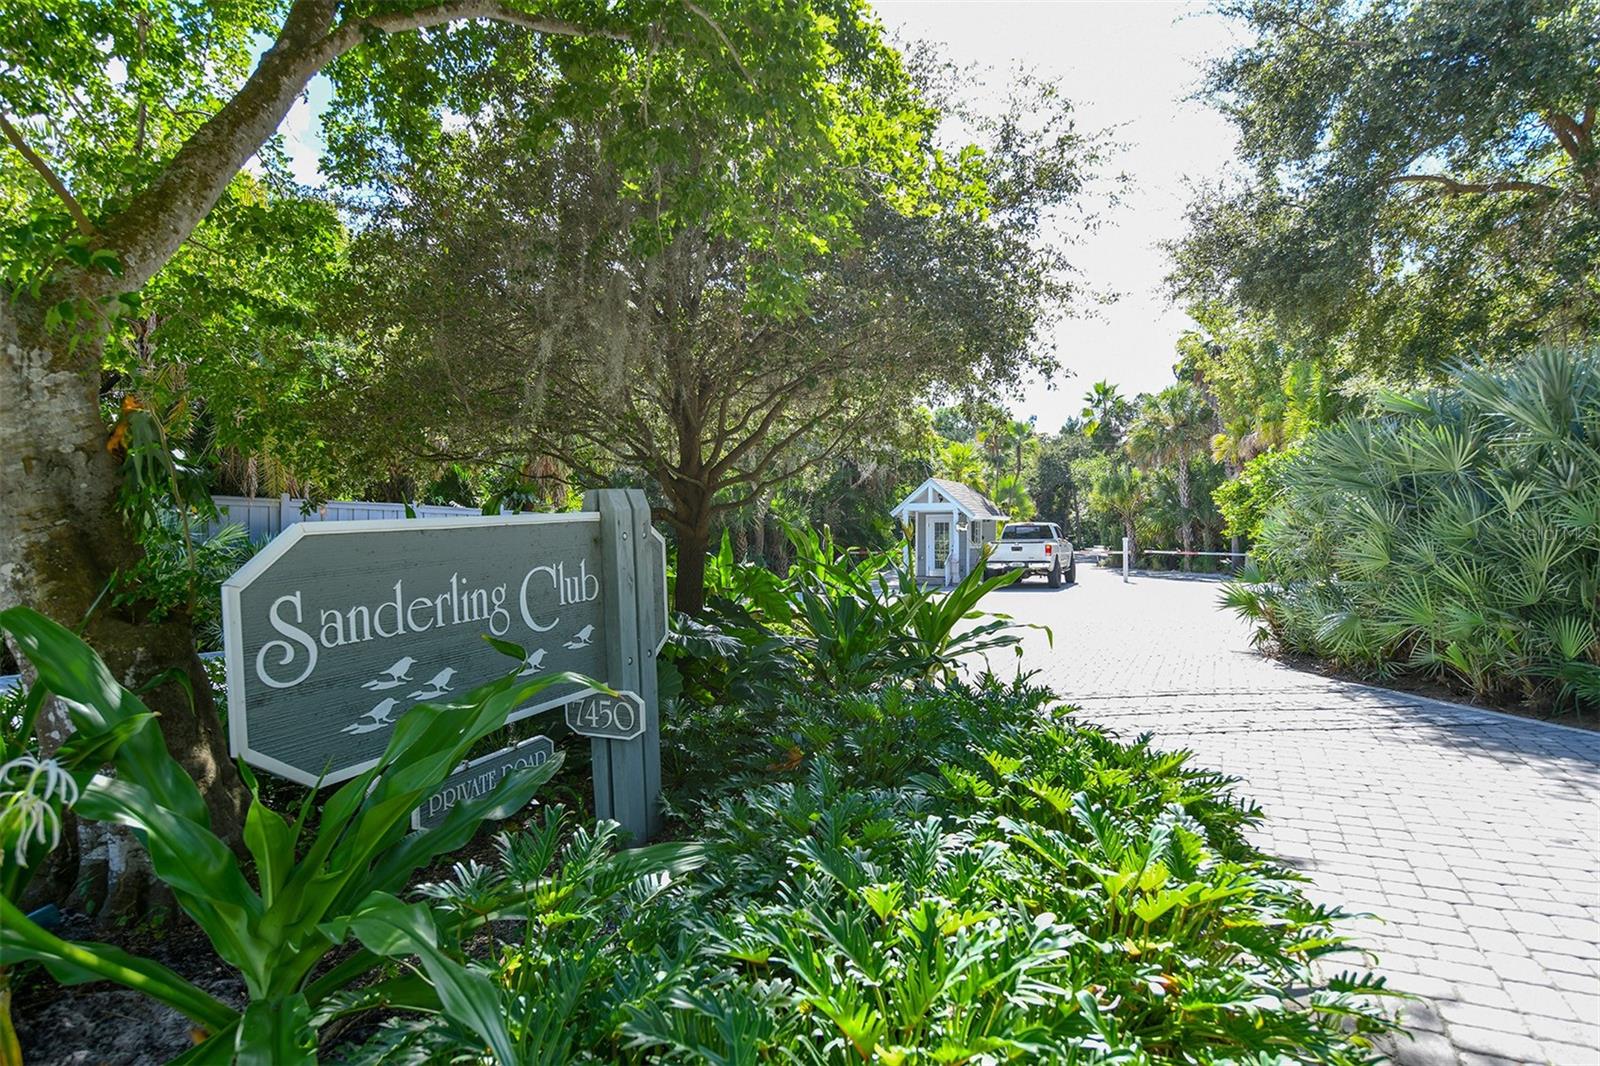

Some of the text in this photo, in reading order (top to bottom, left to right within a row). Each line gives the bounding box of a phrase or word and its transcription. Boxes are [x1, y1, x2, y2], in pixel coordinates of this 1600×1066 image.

[256, 558, 599, 688] Sanderling Club
[572, 699, 634, 731] 7450
[428, 770, 497, 817] PRIVATE
